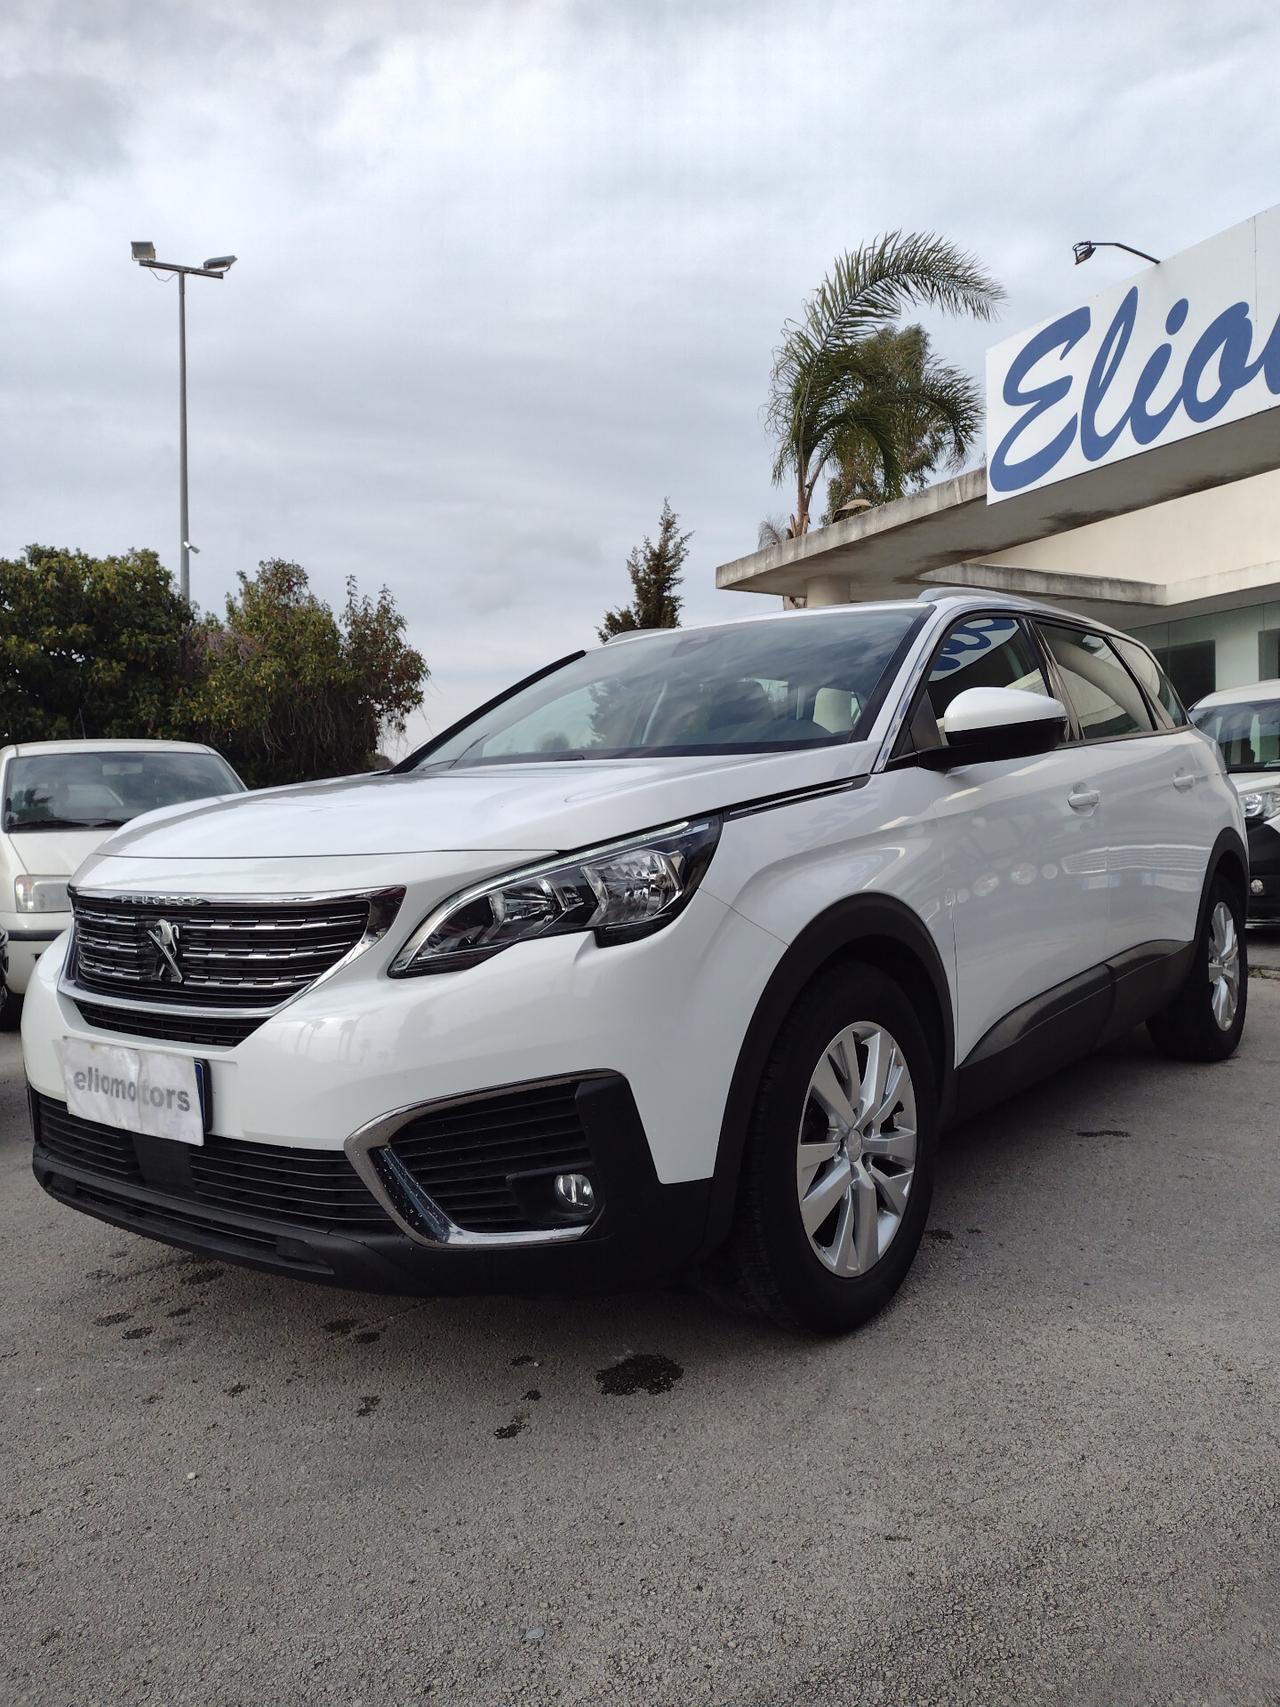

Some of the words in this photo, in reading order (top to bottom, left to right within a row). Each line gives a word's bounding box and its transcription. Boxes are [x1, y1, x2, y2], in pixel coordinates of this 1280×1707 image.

[989, 286, 1280, 492] Elio
[121, 895, 201, 906] PEUGEOT
[73, 1067, 190, 1112] eliomotors
